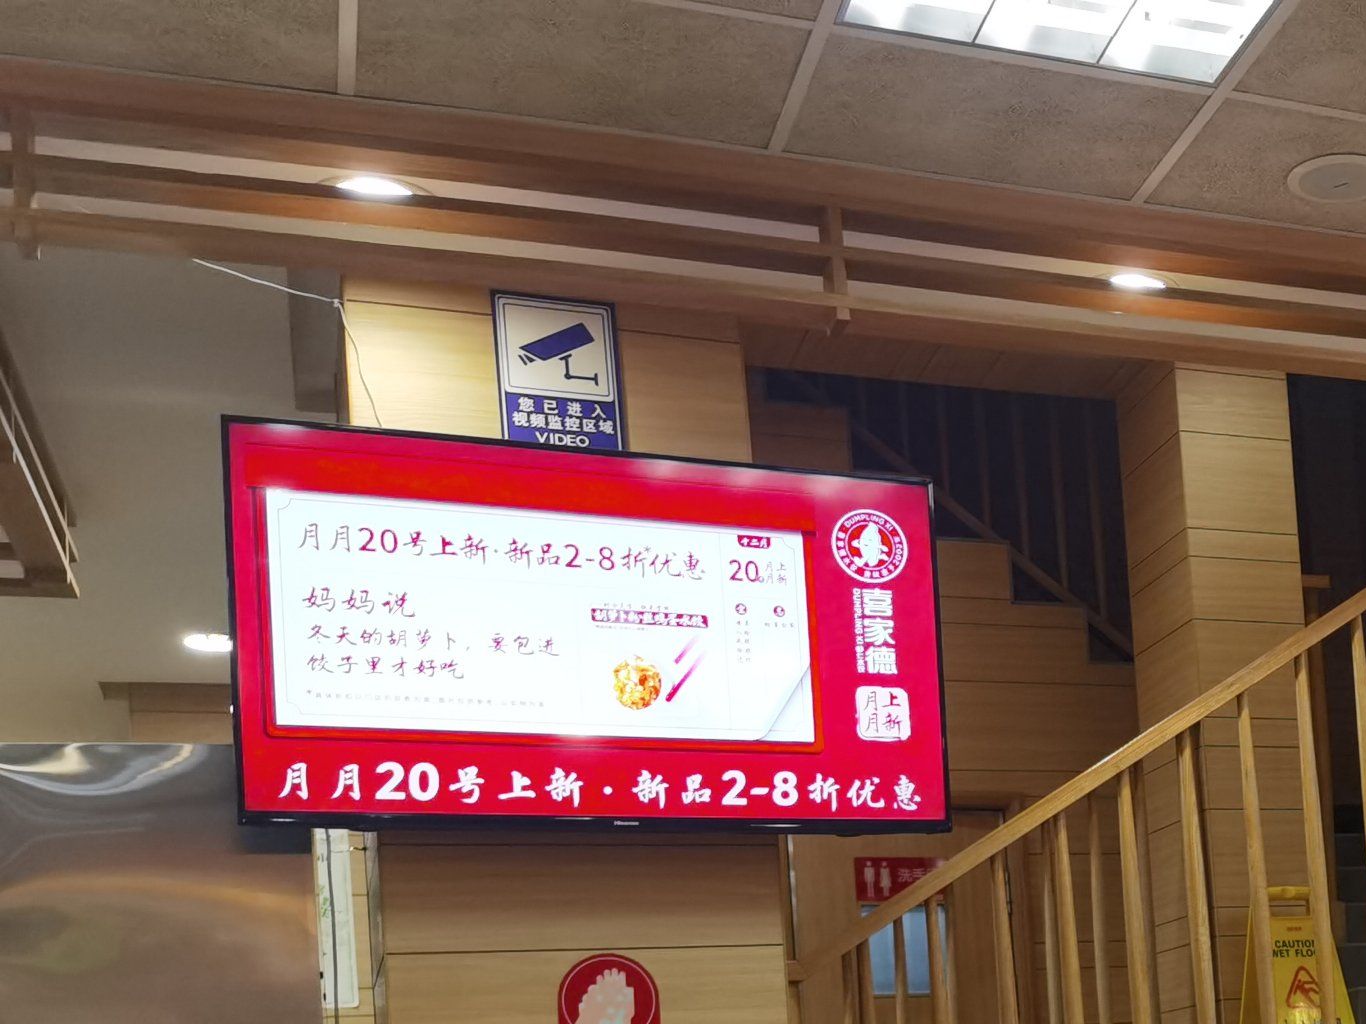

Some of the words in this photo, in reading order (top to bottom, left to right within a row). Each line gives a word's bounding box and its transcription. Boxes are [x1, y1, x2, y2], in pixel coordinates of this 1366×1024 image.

[518, 396, 606, 418] 您已进入
[512, 412, 615, 435] 视频监控区域
[535, 431, 590, 447] VIDEO
[729, 559, 758, 582] 20
[302, 586, 416, 618] 妈妈说
[862, 588, 898, 675] 喜家德
[307, 654, 465, 679] 饺子里才好吃
[897, 866, 936, 882] 洗手
[1274, 940, 1314, 948] CAUTIO
[1295, 949, 1315, 957] FLO
